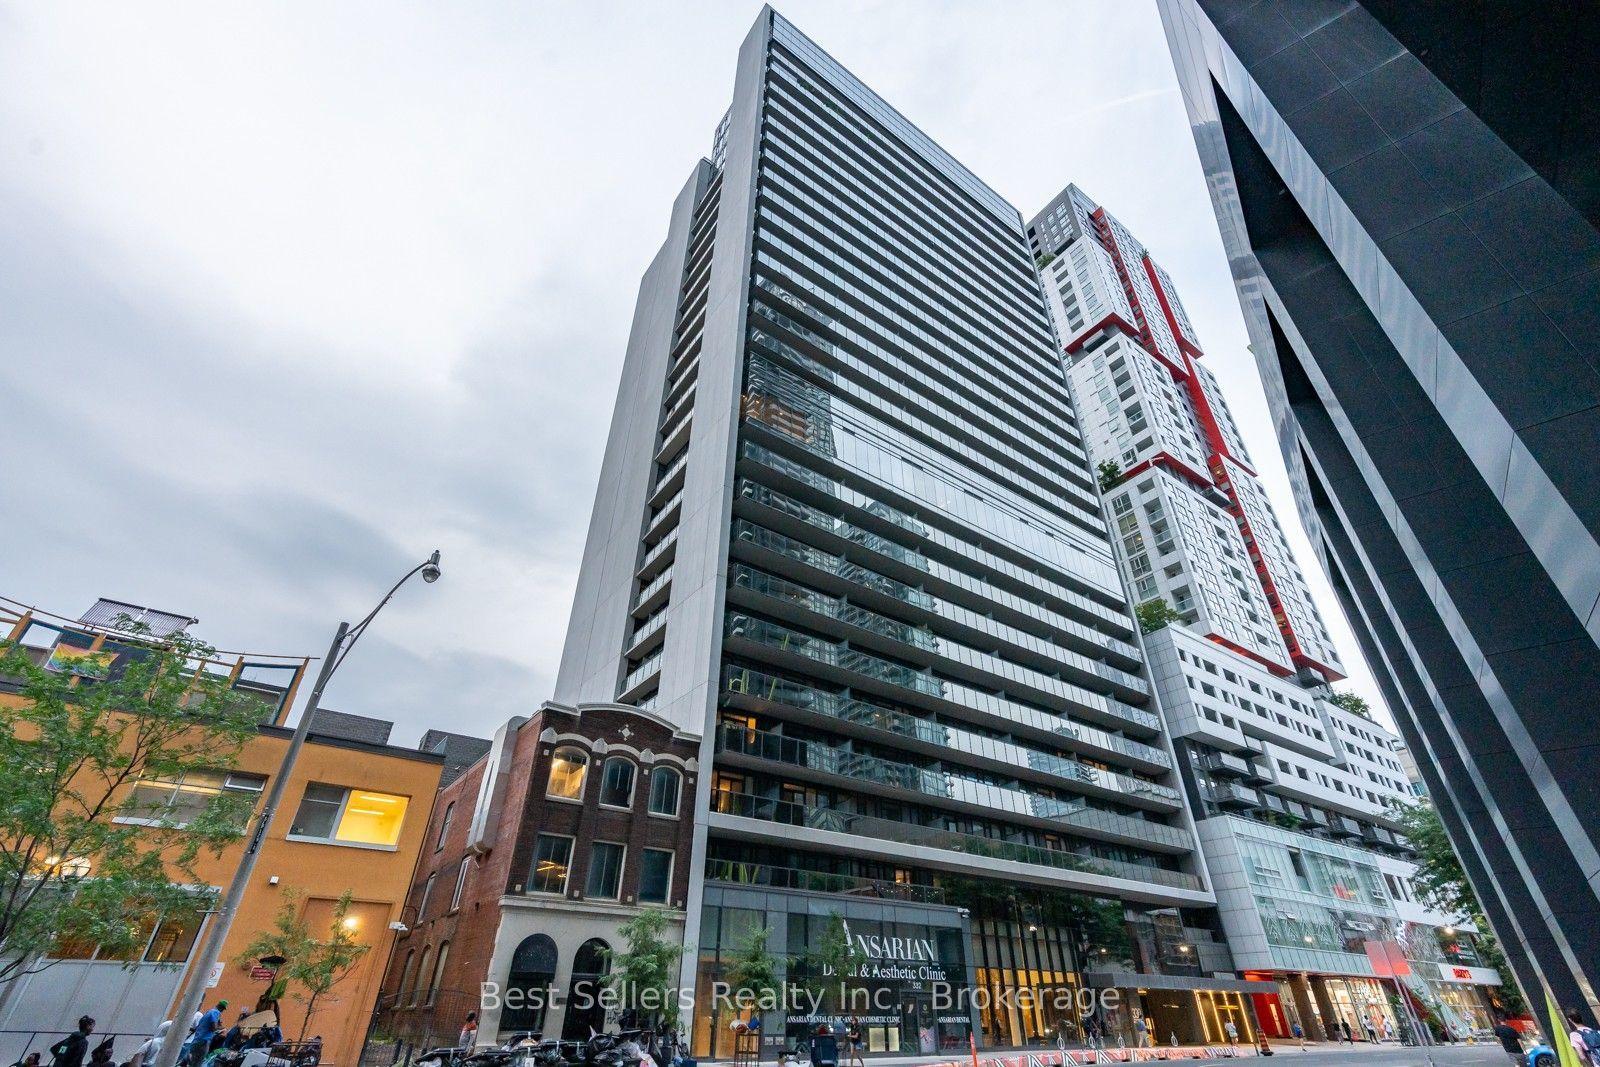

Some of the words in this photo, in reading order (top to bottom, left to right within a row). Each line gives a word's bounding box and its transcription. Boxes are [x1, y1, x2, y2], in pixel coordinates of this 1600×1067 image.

[842, 919, 935, 960] ANSARIAN
[860, 963, 870, 977] &
[872, 964, 917, 980] Aesthetic
[918, 965, 947, 981] Clinic
